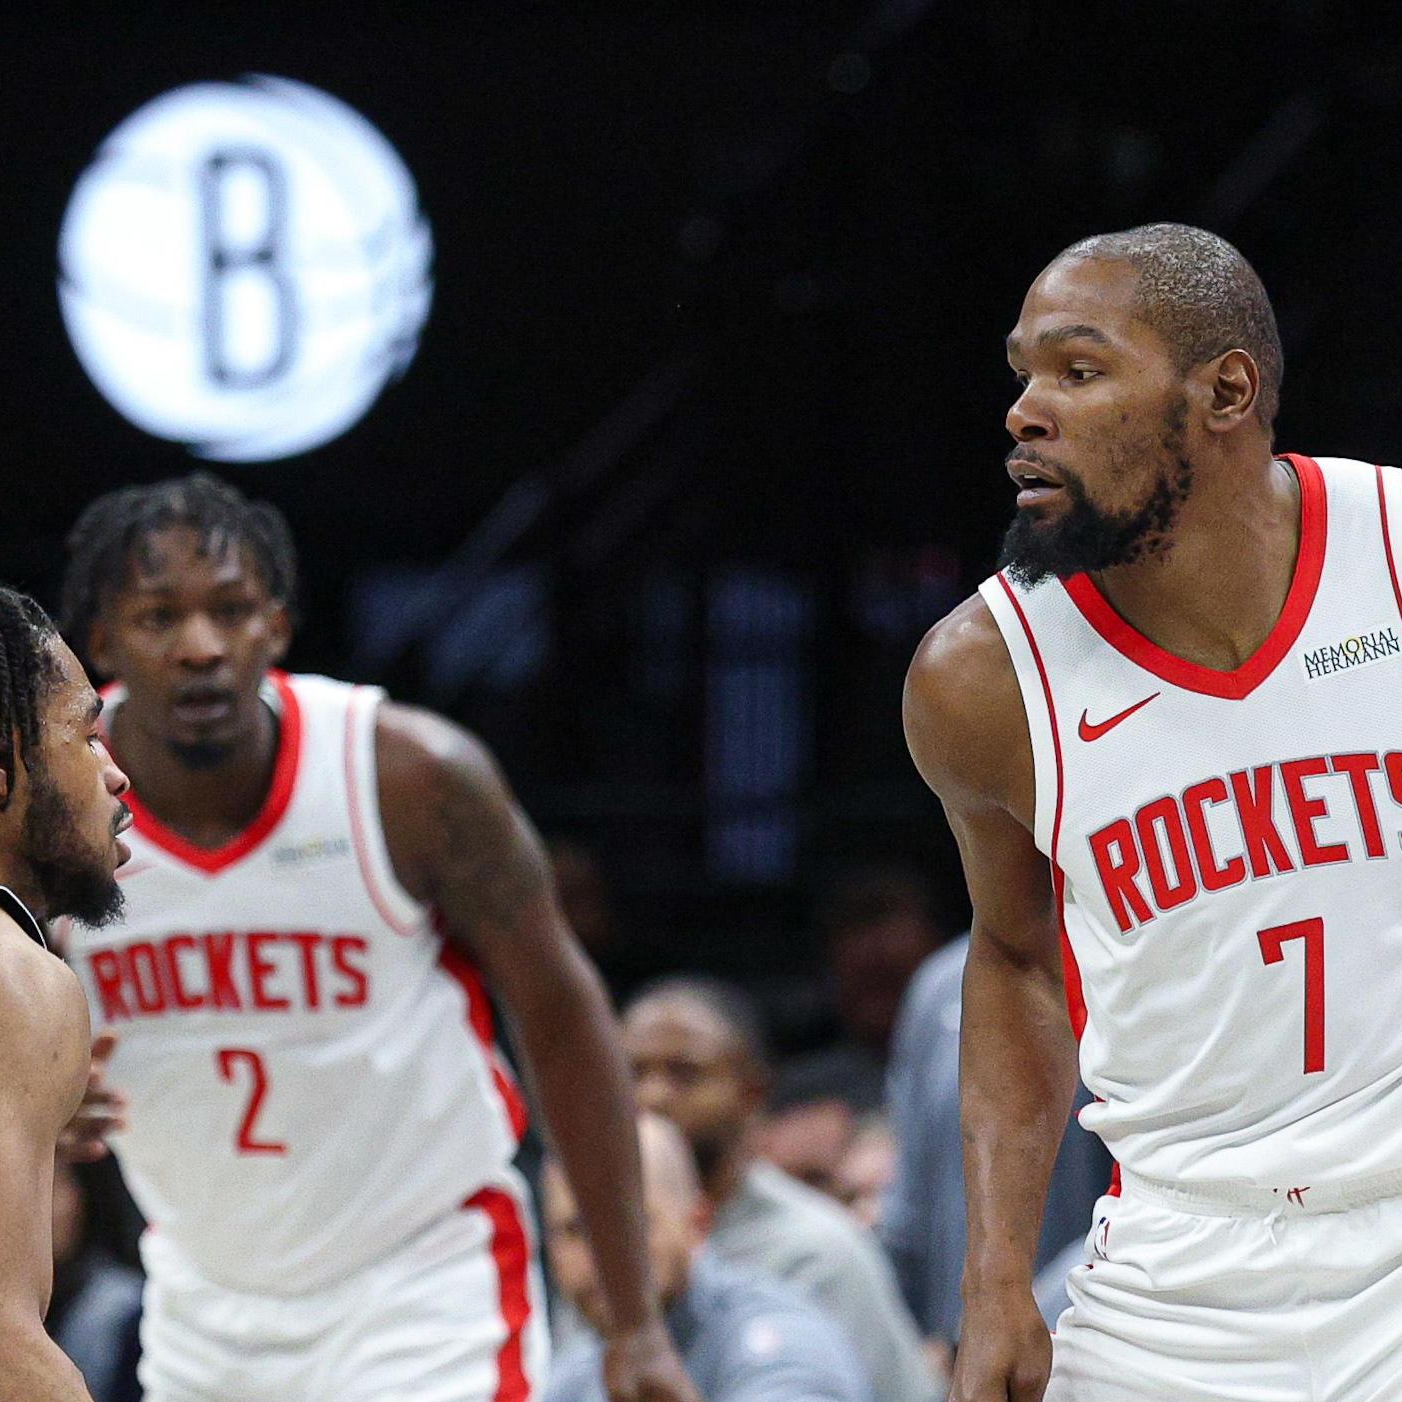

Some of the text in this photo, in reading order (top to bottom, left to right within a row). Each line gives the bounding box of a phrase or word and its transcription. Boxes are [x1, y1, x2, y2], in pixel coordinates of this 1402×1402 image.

[202, 143, 299, 390] B
[1304, 627, 1399, 668] MEMORIAL
[1306, 639, 1401, 679] HERMANN
[87, 929, 372, 1023] ROCKETS
[1256, 916, 1325, 1075] 7
[215, 1047, 287, 1156] 2
